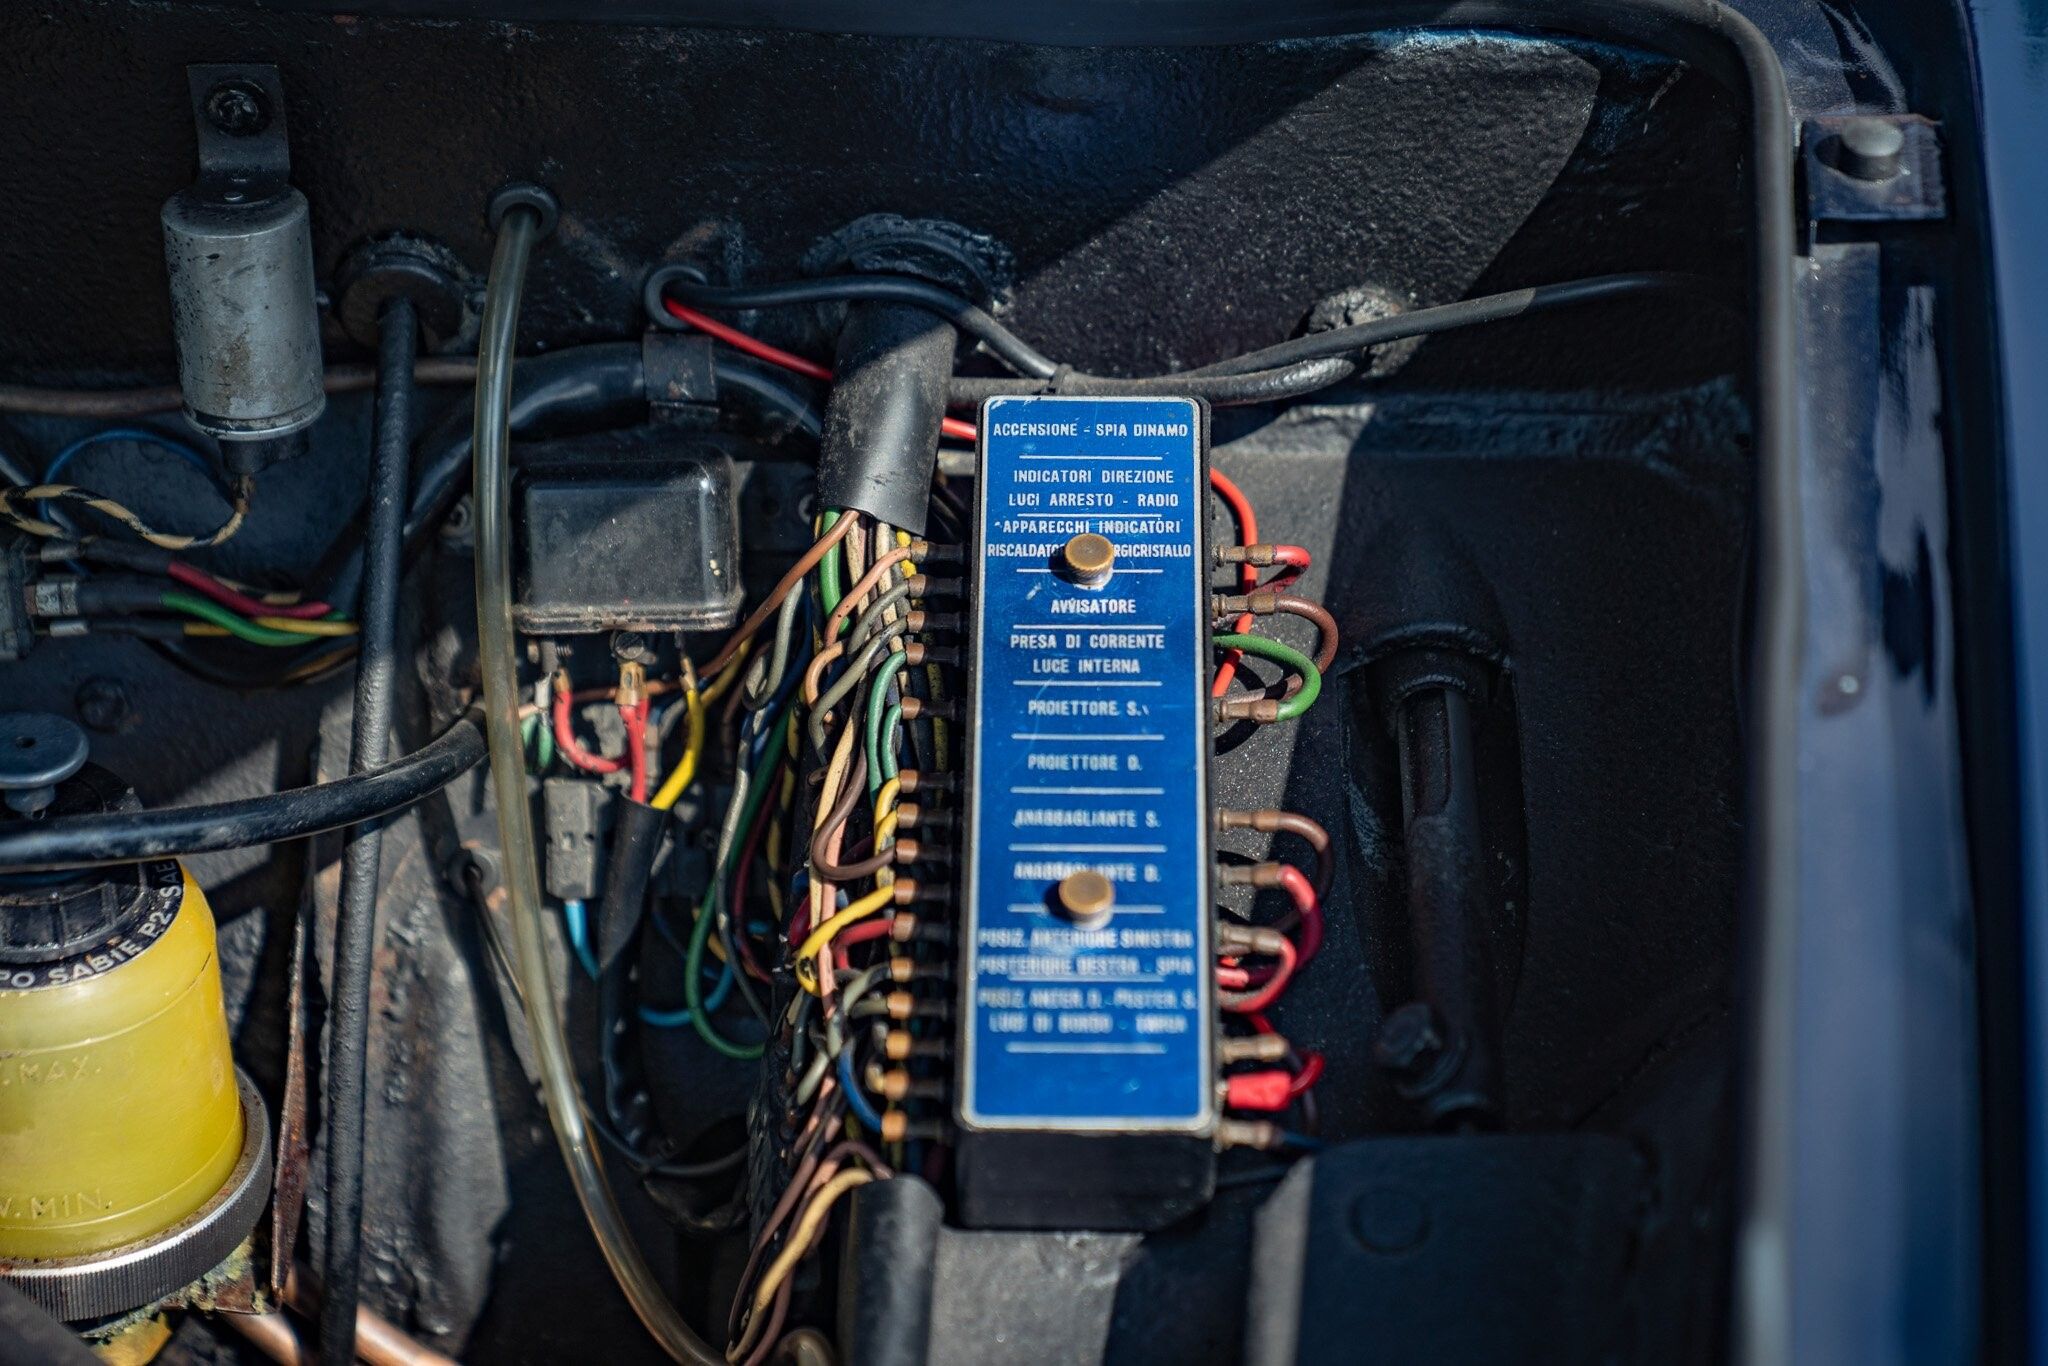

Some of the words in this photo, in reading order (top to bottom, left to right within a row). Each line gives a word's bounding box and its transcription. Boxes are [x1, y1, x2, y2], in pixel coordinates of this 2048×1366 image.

[993, 423, 1078, 437] ACCENSIONE
[1095, 423, 1128, 437] SPIA
[1133, 423, 1188, 437] DINAMO
[1014, 469, 1092, 483] INDICATORI
[1101, 470, 1174, 484] DIREZIONE
[1008, 493, 1040, 507] LUCI
[1049, 493, 1114, 507] ARRESTO
[1137, 493, 1179, 507] RADIO
[1003, 520, 1090, 534] APPARECCHI
[1098, 520, 1181, 534] INDICATORI
[987, 543, 1066, 558] RISCALDATO
[1112, 543, 1192, 558] RGICRISTALLO
[1050, 598, 1137, 614] AVVISATORE
[1010, 633, 1057, 649] PRESA
[1065, 633, 1081, 649] DI
[1089, 633, 1165, 649] CORRENTE
[1033, 658, 1069, 674] LUCE
[1078, 659, 1140, 674] INTERNA
[1028, 700, 1118, 716] PROIETTORE
[1028, 754, 1118, 771] PROIETTORE
[48, 938, 143, 986] SABIE
